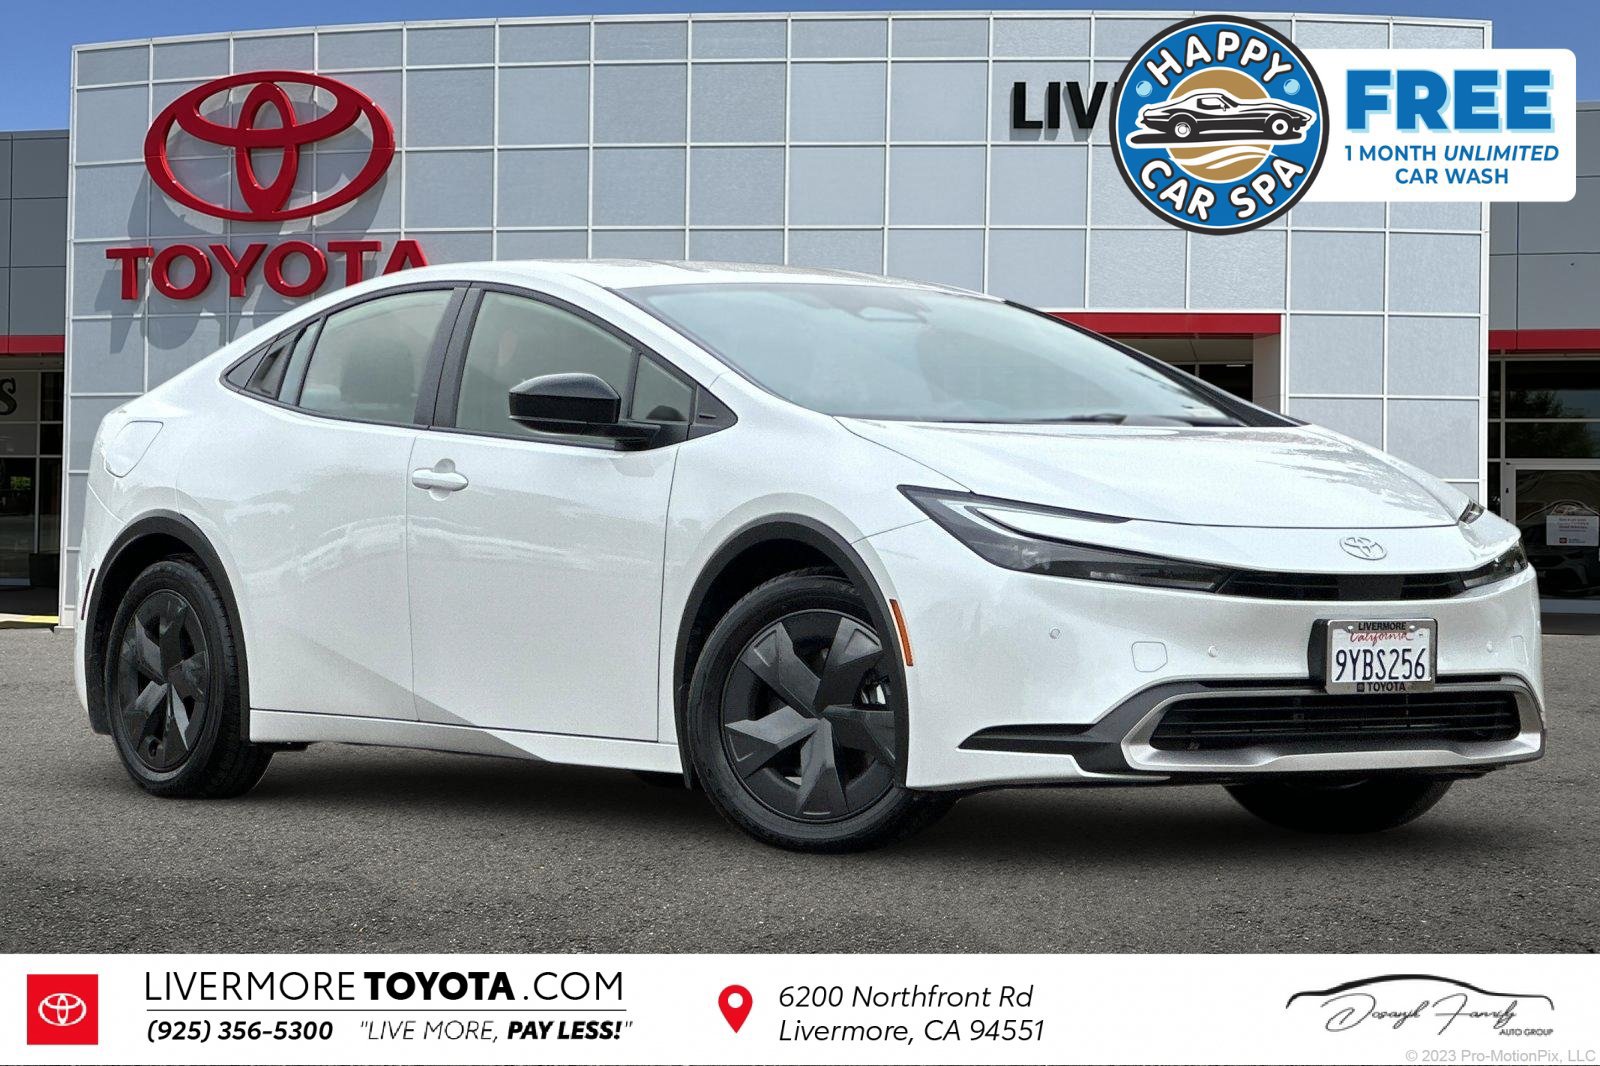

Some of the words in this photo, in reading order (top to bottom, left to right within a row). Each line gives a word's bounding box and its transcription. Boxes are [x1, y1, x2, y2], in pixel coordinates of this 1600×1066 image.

[1013, 81, 1119, 129] LIV
[1358, 622, 1407, 631] LIVERMORE
[1335, 648, 1426, 681] 9YBS256
[1367, 682, 1406, 692] TOYOTA
